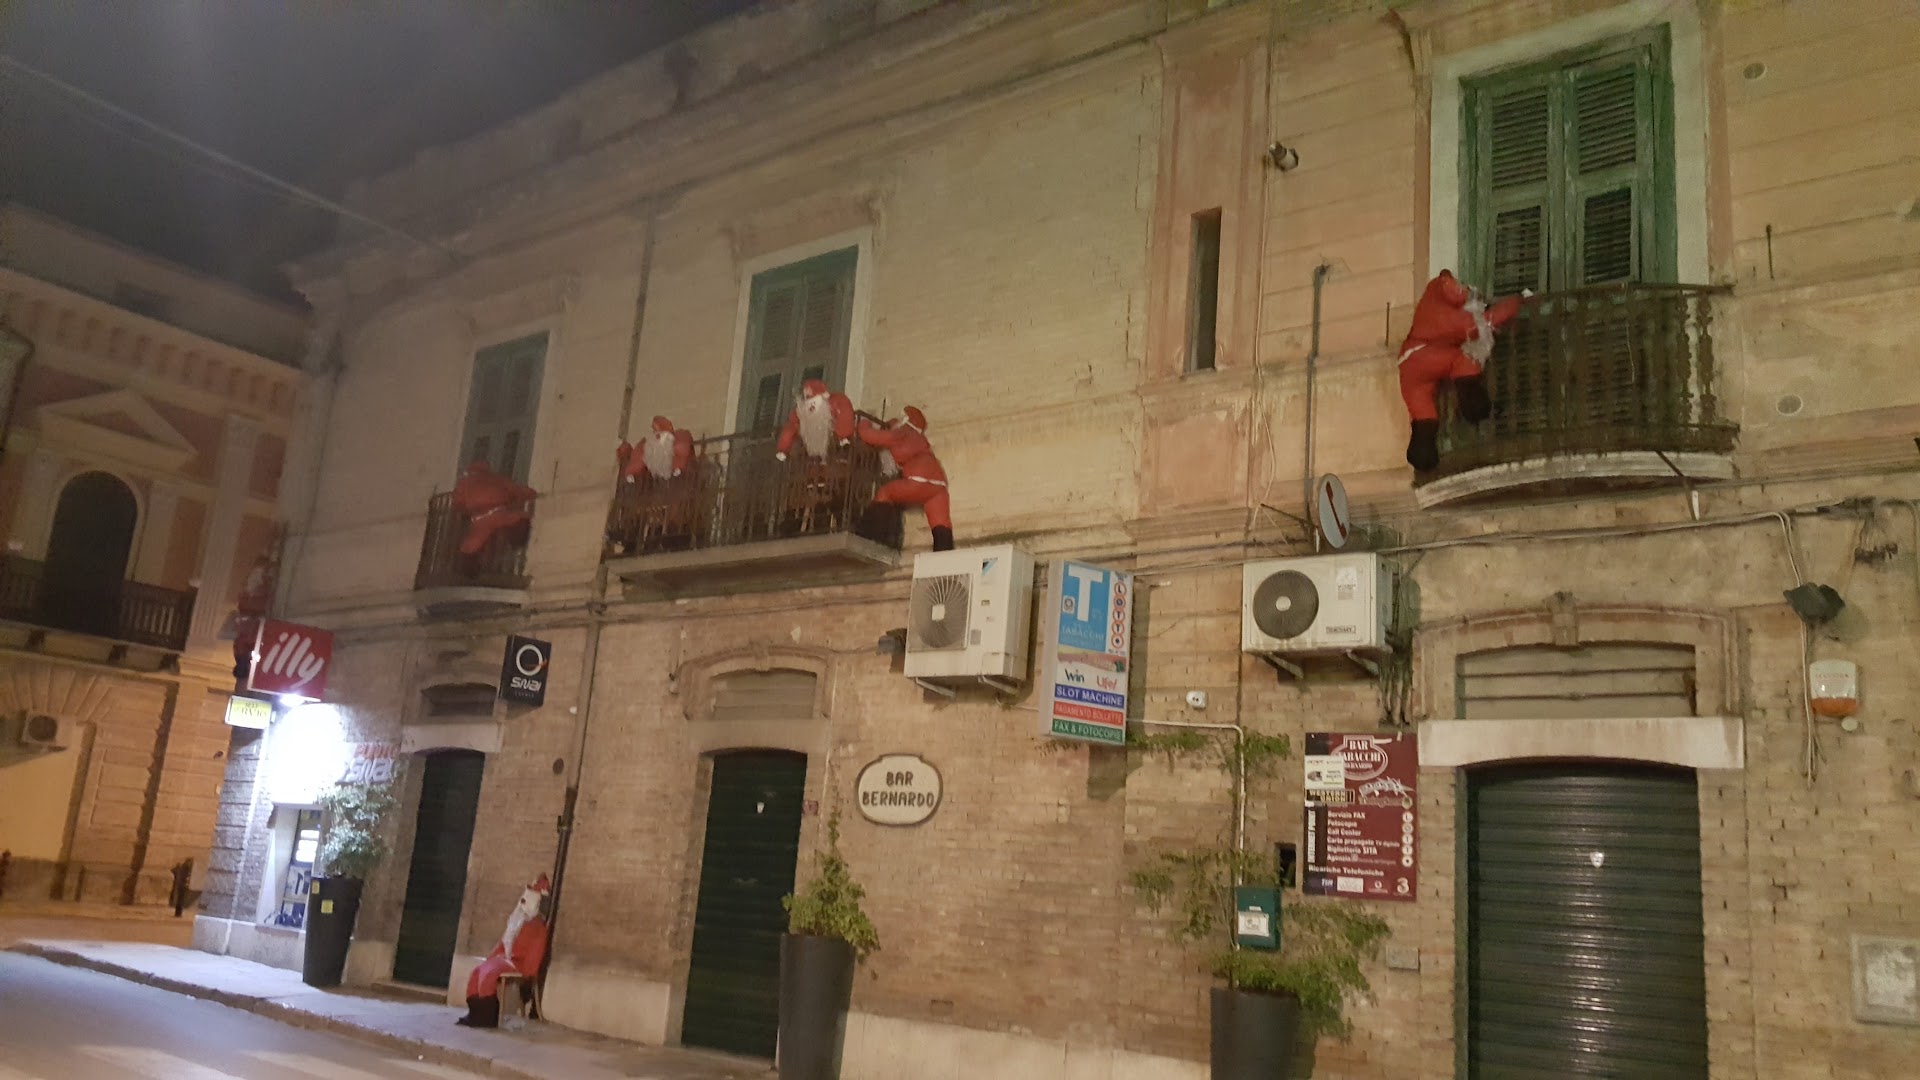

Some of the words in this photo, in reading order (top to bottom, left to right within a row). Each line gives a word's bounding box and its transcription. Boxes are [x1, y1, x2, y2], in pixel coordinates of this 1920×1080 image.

[261, 631, 325, 688] illy
[1064, 668, 1085, 683] Win
[1056, 685, 1081, 698] SLOT
[1082, 689, 1123, 706] MACHINE
[1054, 721, 1069, 732] FAX
[1078, 724, 1121, 739] FOTOCOPIE
[1349, 740, 1368, 750] BAR
[886, 771, 914, 787] BAR
[862, 790, 935, 808] BERNARDO
[1327, 811, 1353, 819] Servizio
[1353, 811, 1366, 819] FAX
[1362, 846, 1378, 855] SITA
[1308, 865, 1342, 874] Ricariche
[1343, 867, 1385, 876] Telefoniche
[1396, 877, 1410, 894] 3
